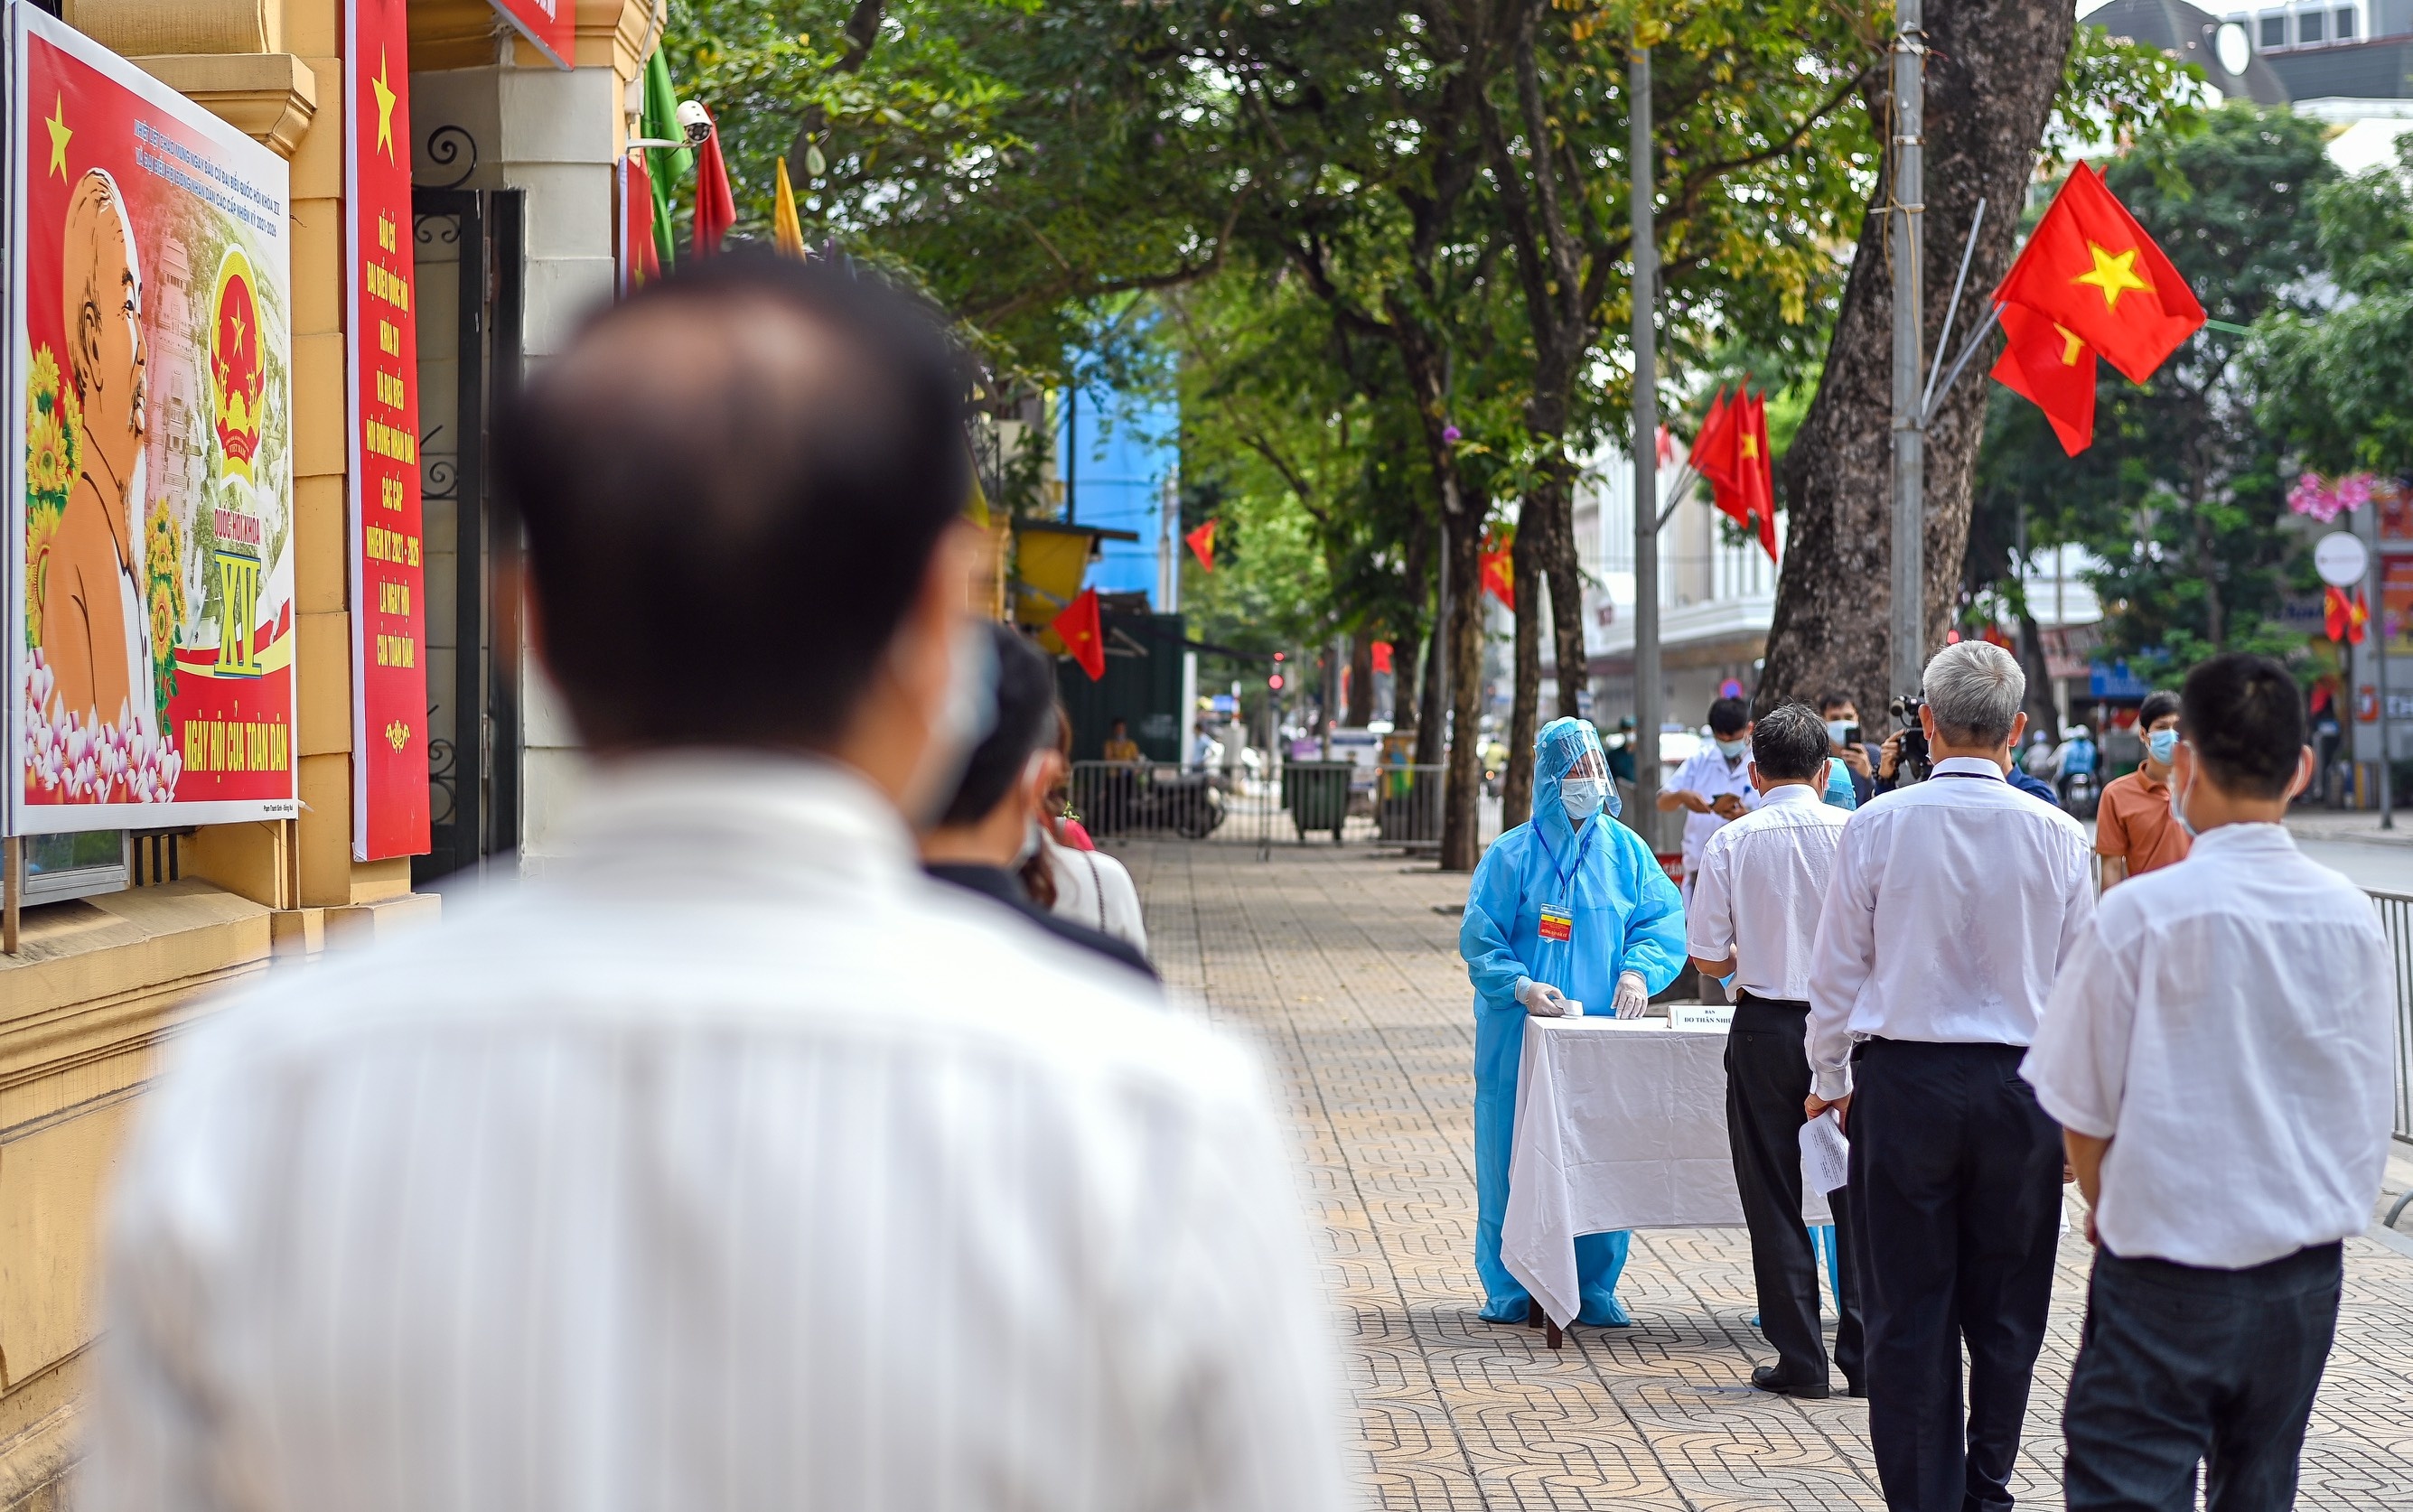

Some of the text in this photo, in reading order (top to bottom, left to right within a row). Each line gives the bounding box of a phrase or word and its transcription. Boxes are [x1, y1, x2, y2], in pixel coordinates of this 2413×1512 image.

[376, 364, 385, 404] VÀ
[366, 413, 377, 459] HỘI
[376, 413, 391, 458] ĐỒNG
[381, 470, 404, 513] CÁC CẤP
[214, 499, 232, 541] QUỐC
[232, 507, 243, 548] HỘI
[366, 520, 385, 567] NHIỆM
[391, 531, 404, 565] 2021
[407, 535, 420, 568] 2026
[214, 549, 262, 678] XV
[379, 574, 410, 624] LÀ NGÀY HỘI
[377, 620, 388, 667] CỦA
[388, 629, 402, 668] TOÀN
[183, 698, 288, 784] NGÀY HỘI CỦA TOÀN DÂN
